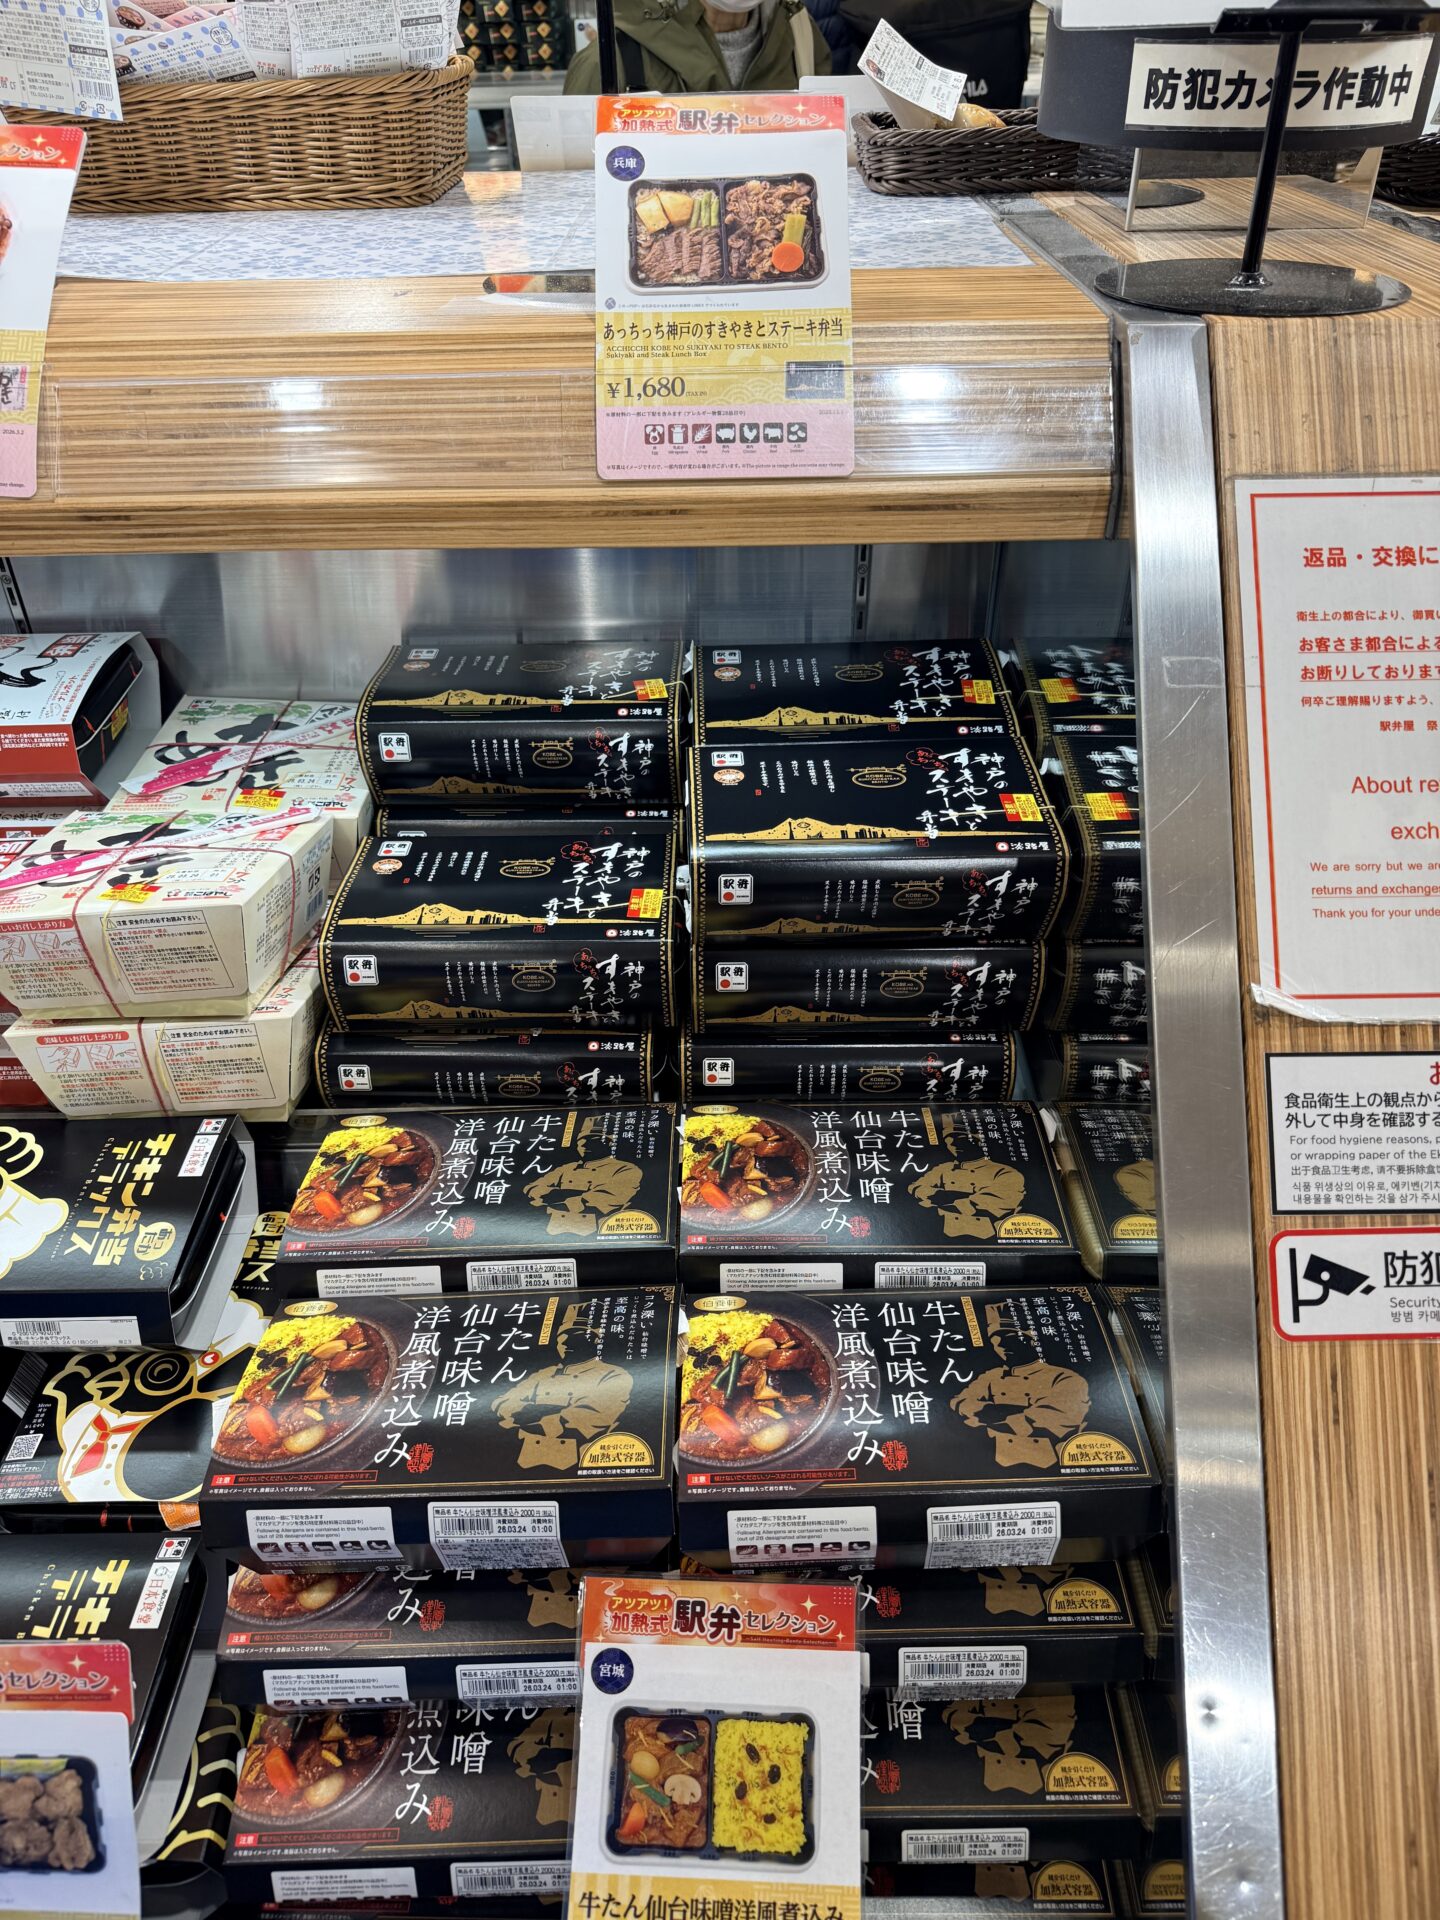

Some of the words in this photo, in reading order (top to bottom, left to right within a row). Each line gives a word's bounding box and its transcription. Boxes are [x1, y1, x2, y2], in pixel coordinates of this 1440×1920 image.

[963, 78, 988, 98] ILA
[621, 119, 674, 132] 加熱式
[677, 109, 740, 134] 駅弁
[742, 113, 827, 127] セレクション
[613, 157, 637, 170] 兵庫
[603, 318, 843, 341] あっちっち神戸のすきやきとステーキ弁当
[606, 376, 686, 400] ¥1,680
[1304, 546, 1439, 568] 返品・交換に
[1380, 720, 1414, 731] 駅弁屋
[970, 752, 1008, 789] 神戸の
[926, 769, 959, 826] ステーキ
[938, 748, 988, 830] すきやきと
[1351, 776, 1413, 794] About
[1419, 778, 1440, 793] re
[916, 810, 939, 839] 弁当
[620, 847, 652, 878] 神戸の
[1310, 862, 1328, 872] We
[1333, 864, 1350, 872] are
[1355, 863, 1382, 873] sorry
[1386, 862, 1403, 871] but
[562, 862, 590, 914] ステーキ
[1312, 884, 1352, 895] returns
[1356, 884, 1378, 894] and
[1382, 884, 1440, 896] exchange
[542, 899, 565, 926] 弁当
[1312, 908, 1346, 918] Thank
[1349, 910, 1368, 920] you
[1372, 908, 1386, 918] for
[1388, 909, 1412, 920] your
[522, 1115, 563, 1174] 牛たん
[888, 1111, 929, 1174] 牛たん
[1290, 1135, 1308, 1144] For
[1311, 1135, 1336, 1144] food
[1340, 1135, 1383, 1146] hygiene
[1386, 1136, 1432, 1146] reasons,
[474, 1116, 525, 1204] 仙台味噌
[850, 1110, 894, 1204] 仙台味噌
[1305, 1150, 1356, 1161] wrapping
[1359, 1152, 1391, 1161] paper
[1394, 1150, 1406, 1160] of
[1408, 1150, 1426, 1159] the
[426, 1118, 486, 1235] 洋風煮込み
[811, 1111, 854, 1233] 洋風煮込み
[64, 1141, 142, 1256] デラックス
[1292, 1181, 1311, 1192] 식품
[1314, 1181, 1354, 1192] 위생상의
[1356, 1180, 1388, 1192] 이유로,
[1292, 1194, 1332, 1204] 내용물을
[1334, 1193, 1374, 1204] 확인하는
[1377, 1192, 1396, 1204] 것을
[1400, 1192, 1418, 1204] 삼가
[92, 1134, 176, 1266] チキン弁当
[610, 1296, 628, 1339] 至高の味。
[640, 1295, 655, 1329] コク深い、
[1032, 1297, 1060, 1342] 至高の味。
[1060, 1296, 1085, 1331] コク深い、
[1391, 1310, 1414, 1323] 방범
[490, 1302, 542, 1382] 牛たん
[922, 1302, 974, 1384] 牛たん
[432, 1303, 498, 1426] 仙台味噌
[878, 1302, 933, 1425] 仙台味噌
[374, 1304, 452, 1468] 洋風煮込み
[832, 1304, 886, 1466] 洋風煮込み
[588, 1452, 646, 1464] 加熱式容器
[1068, 1451, 1126, 1462] 加熱式容器
[216, 1476, 231, 1484] 注意
[691, 1476, 706, 1484] 注意
[996, 1528, 1026, 1537] 26.03.24
[1031, 1526, 1053, 1535] 01:00
[24, 1564, 56, 1622] Chicken
[66, 1559, 130, 1641] チキ
[612, 1596, 668, 1610] アツアツ!
[1054, 1599, 1110, 1610] 加熱式容器
[611, 1612, 669, 1635] 加熱式
[674, 1598, 742, 1642] 駅弁
[744, 1610, 835, 1634] セレクション
[9, 1672, 108, 1690] セレクション
[599, 1662, 626, 1678] 宮城
[966, 1669, 994, 1677] 26.03.24
[999, 1668, 1020, 1676] 01:00
[523, 1684, 552, 1692] 26.03.24
[1054, 1776, 1109, 1788] 加熱式容器
[1040, 1884, 1094, 1898] 加熱式容器
[578, 1891, 845, 1920] 牛たん仙台味噌洋風煮込み
